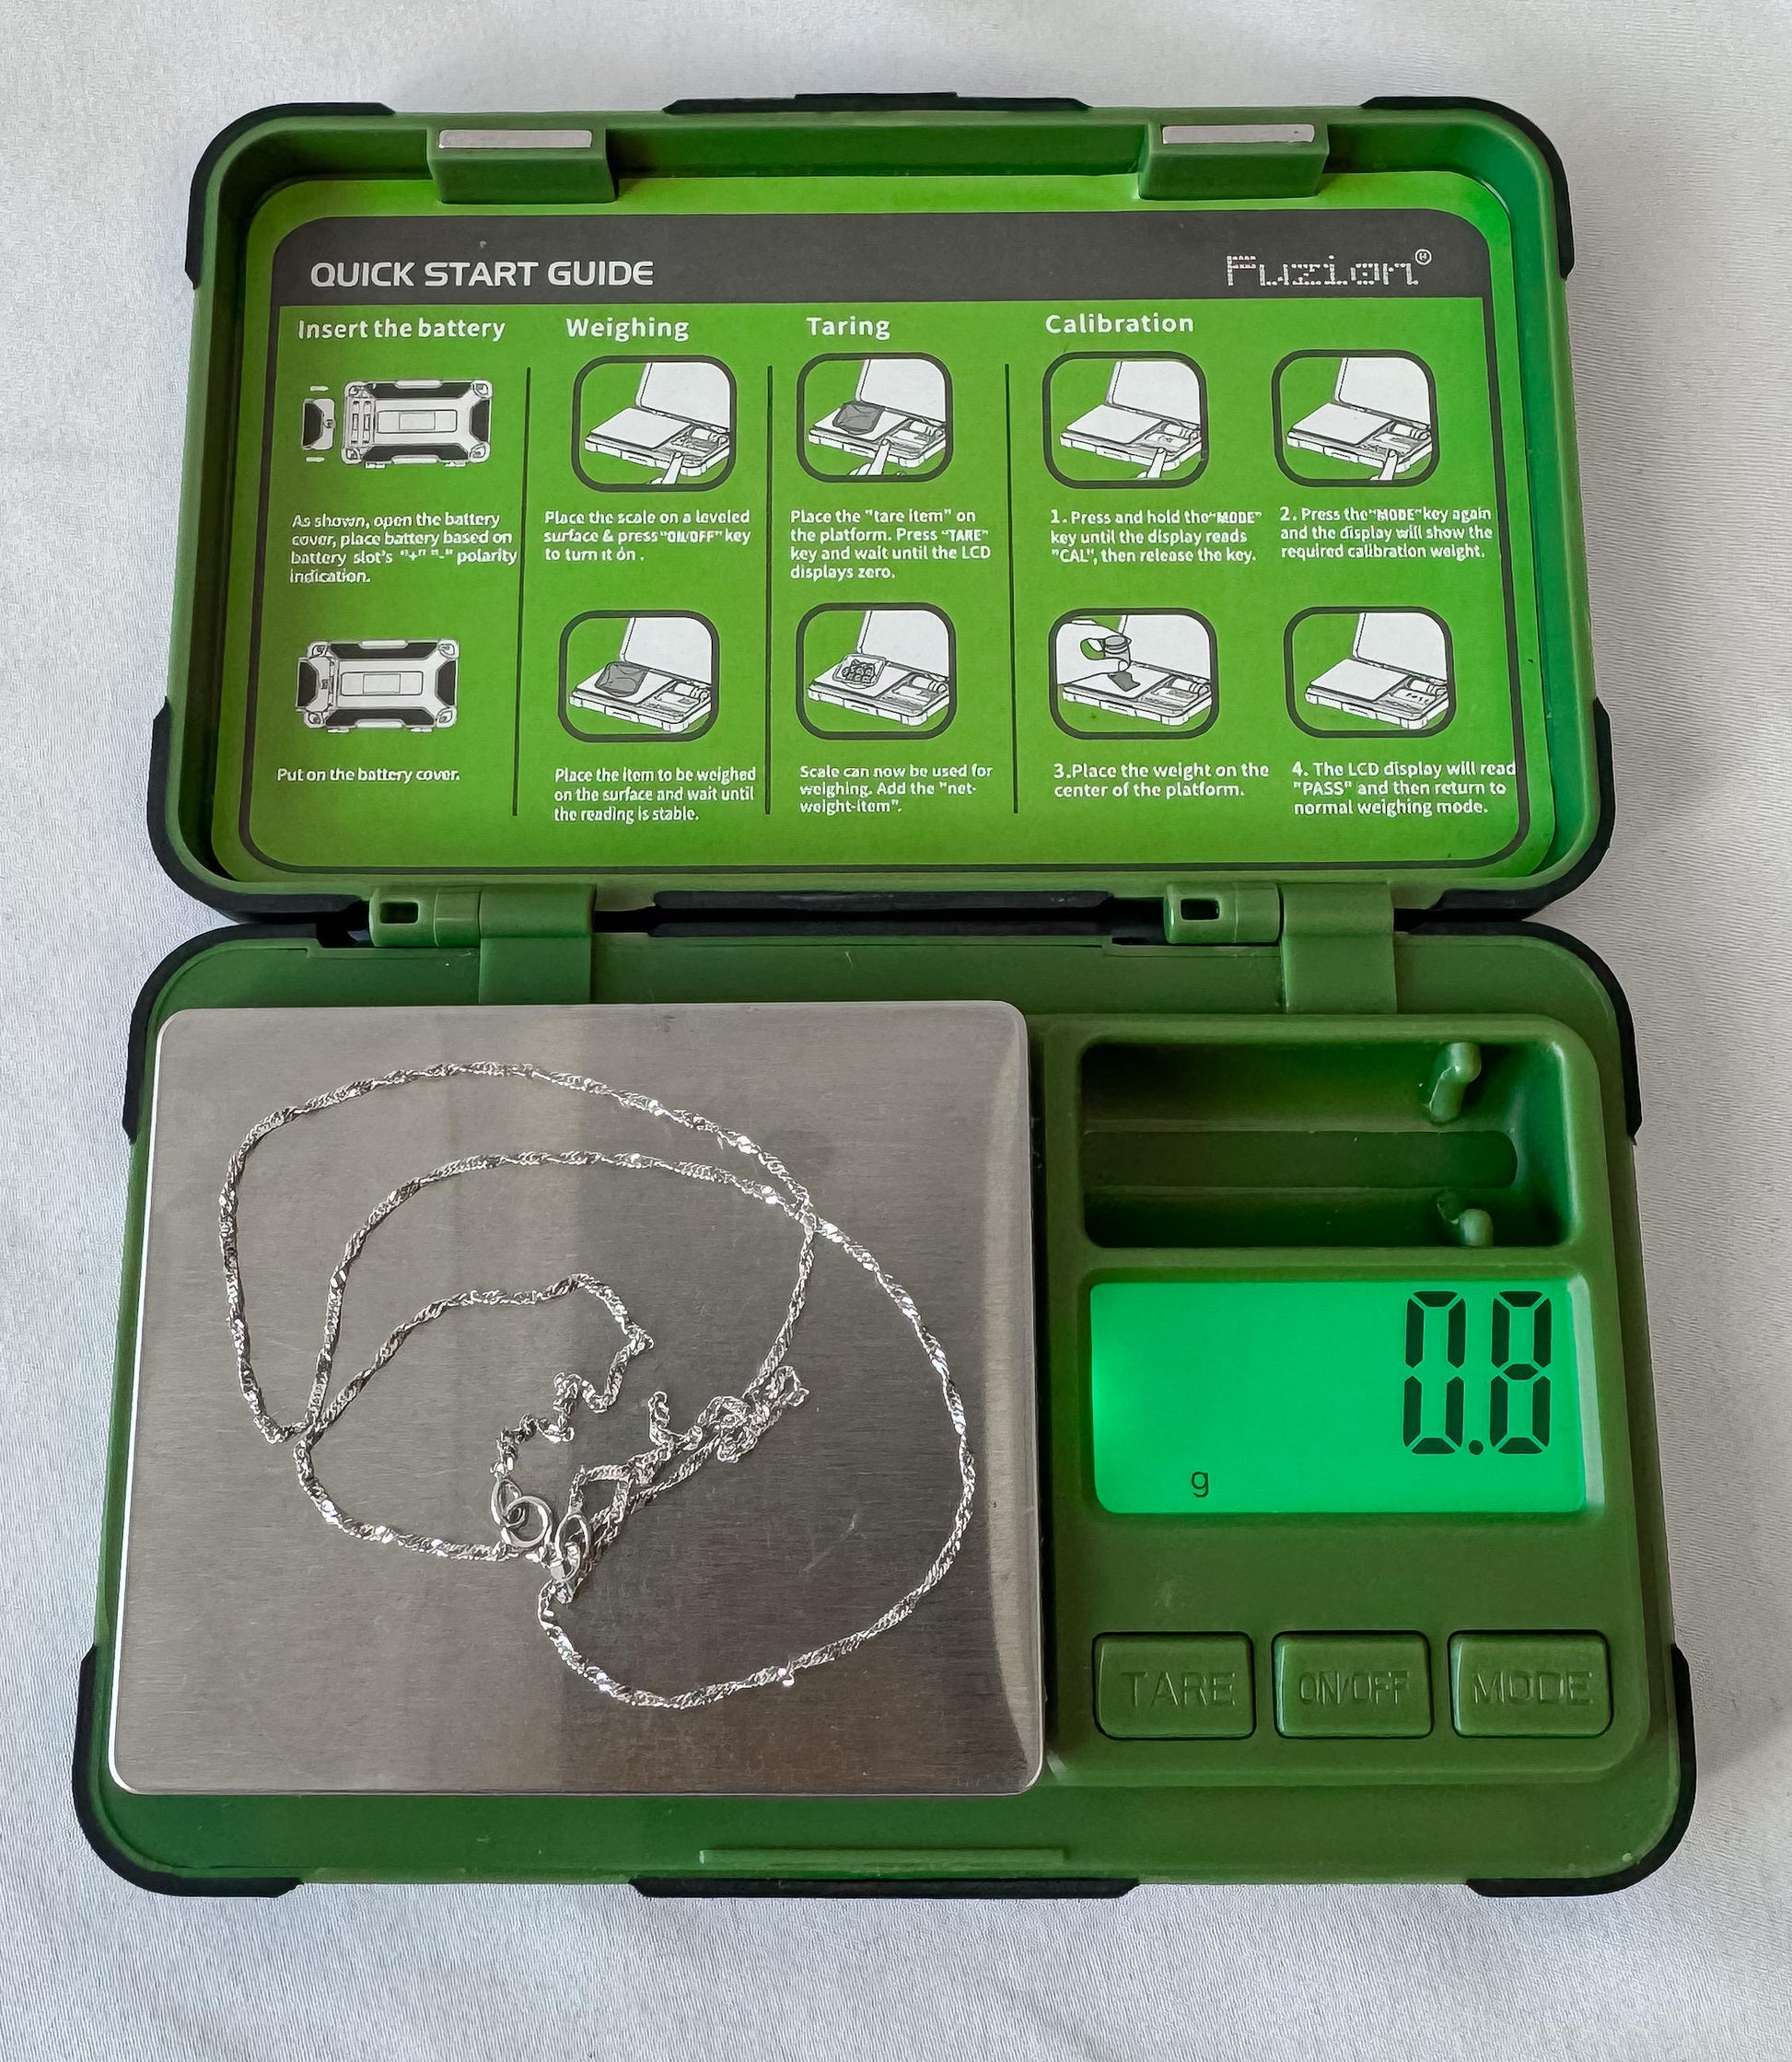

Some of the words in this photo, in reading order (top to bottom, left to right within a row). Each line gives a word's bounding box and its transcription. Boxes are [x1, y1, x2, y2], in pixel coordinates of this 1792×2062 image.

[310, 262, 415, 287] QUICK
[425, 261, 540, 286] START
[547, 261, 654, 286] GUIDE
[298, 320, 368, 339] Insert
[373, 318, 413, 338] the
[418, 317, 506, 343] battery
[565, 316, 690, 343] Weighing
[806, 315, 890, 341] Taring
[1045, 311, 1193, 334] Calibration
[292, 514, 311, 528] As
[314, 513, 370, 530] shown,
[373, 516, 413, 530] open
[415, 511, 442, 527] the
[444, 511, 500, 529] battery
[544, 509, 585, 525] Place
[588, 510, 614, 524] the
[617, 509, 657, 525] scale
[658, 512, 679, 524] on
[682, 512, 692, 524] a
[695, 508, 751, 524] leveled
[790, 508, 832, 524] Place
[834, 508, 861, 524] the
[956, 511, 976, 522] on
[1071, 510, 1112, 525] Press
[1114, 509, 1144, 525] and
[1146, 509, 1181, 524] hold
[1301, 507, 1341, 521] Press
[1452, 507, 1492, 524] again
[292, 535, 337, 549] cover,
[340, 531, 381, 549] place
[384, 530, 440, 548] battery
[442, 530, 490, 544] based
[492, 532, 513, 544] on
[543, 528, 599, 543] surface
[601, 528, 614, 542] &
[725, 528, 751, 546] key
[790, 527, 817, 542] the
[820, 526, 892, 545] platform.
[896, 527, 938, 542] Press
[1050, 530, 1077, 548] key
[1080, 529, 1116, 544] until
[1119, 529, 1145, 544] the
[1147, 528, 1202, 547] display
[1205, 528, 1248, 543] reads
[1280, 524, 1309, 540] and
[1311, 525, 1336, 540] the
[1339, 524, 1393, 543] display
[1395, 524, 1423, 541] will
[1425, 524, 1465, 540] show
[1468, 524, 1493, 540] the
[291, 551, 347, 567] battery
[456, 547, 518, 566] polarity
[545, 547, 561, 561] to
[564, 548, 598, 562] turn
[600, 548, 613, 561] it
[616, 545, 636, 561] on
[790, 545, 818, 564] key
[820, 545, 851, 561] and
[854, 544, 889, 560] wait
[891, 544, 929, 560] until
[931, 544, 958, 560] the
[961, 545, 991, 560] LCD
[1100, 547, 1136, 563] then
[1139, 547, 1194, 563] release
[1197, 546, 1223, 562] the
[1226, 546, 1257, 565] key.
[1281, 542, 1344, 562] required
[1347, 542, 1427, 559] calibration
[1429, 542, 1485, 562] weight.
[289, 567, 371, 584] indication.
[790, 564, 855, 582] displays
[857, 566, 896, 579] zero.
[277, 768, 304, 782] Put
[306, 770, 326, 781] on
[330, 767, 355, 781] the
[357, 766, 413, 785] battery
[415, 769, 460, 781] cover.
[554, 767, 593, 783] Place
[596, 767, 620, 783] the
[623, 766, 655, 783] item
[657, 768, 672, 782] to
[675, 766, 694, 782] be
[696, 765, 756, 786] weighed
[799, 763, 840, 778] Scale
[843, 767, 870, 778] can
[872, 767, 906, 778] now
[909, 763, 928, 778] be
[932, 763, 968, 778] used
[971, 763, 994, 777] for
[1120, 762, 1149, 778] the
[1152, 762, 1212, 782] weight
[1215, 765, 1238, 777] on
[1240, 762, 1270, 777] the
[1291, 761, 1309, 777] 4.
[1312, 761, 1344, 777] The
[1347, 762, 1379, 776] LCD
[1383, 761, 1442, 780] display
[1446, 760, 1476, 776] will
[1480, 760, 1517, 776] read
[553, 790, 573, 802] on
[575, 786, 599, 802] the
[601, 786, 654, 802] surface
[657, 786, 684, 801] and
[687, 785, 718, 801] wait
[721, 785, 754, 801] until
[799, 780, 873, 798] weighing.
[876, 781, 906, 796] Add
[910, 781, 935, 795] the
[1053, 784, 1109, 798] center
[1111, 781, 1130, 798] of
[1133, 781, 1162, 798] the
[1166, 780, 1245, 800] platform.
[1356, 779, 1389, 796] and
[1391, 779, 1430, 796] then
[1434, 781, 1485, 795] return
[1489, 781, 1507, 795] to
[554, 805, 577, 821] the
[580, 805, 634, 825] reading
[637, 805, 650, 821] is
[652, 805, 699, 821] stable.
[1294, 798, 1354, 815] normal
[1356, 798, 1433, 819] weighing
[1436, 798, 1489, 814] mode.
[1402, 1290, 1553, 1455] 0.8
[1191, 1471, 1209, 1497] g
[1120, 1670, 1237, 1708] TARE
[1297, 1669, 1411, 1707] ON/OFF
[1472, 1670, 1594, 1707] MODE
